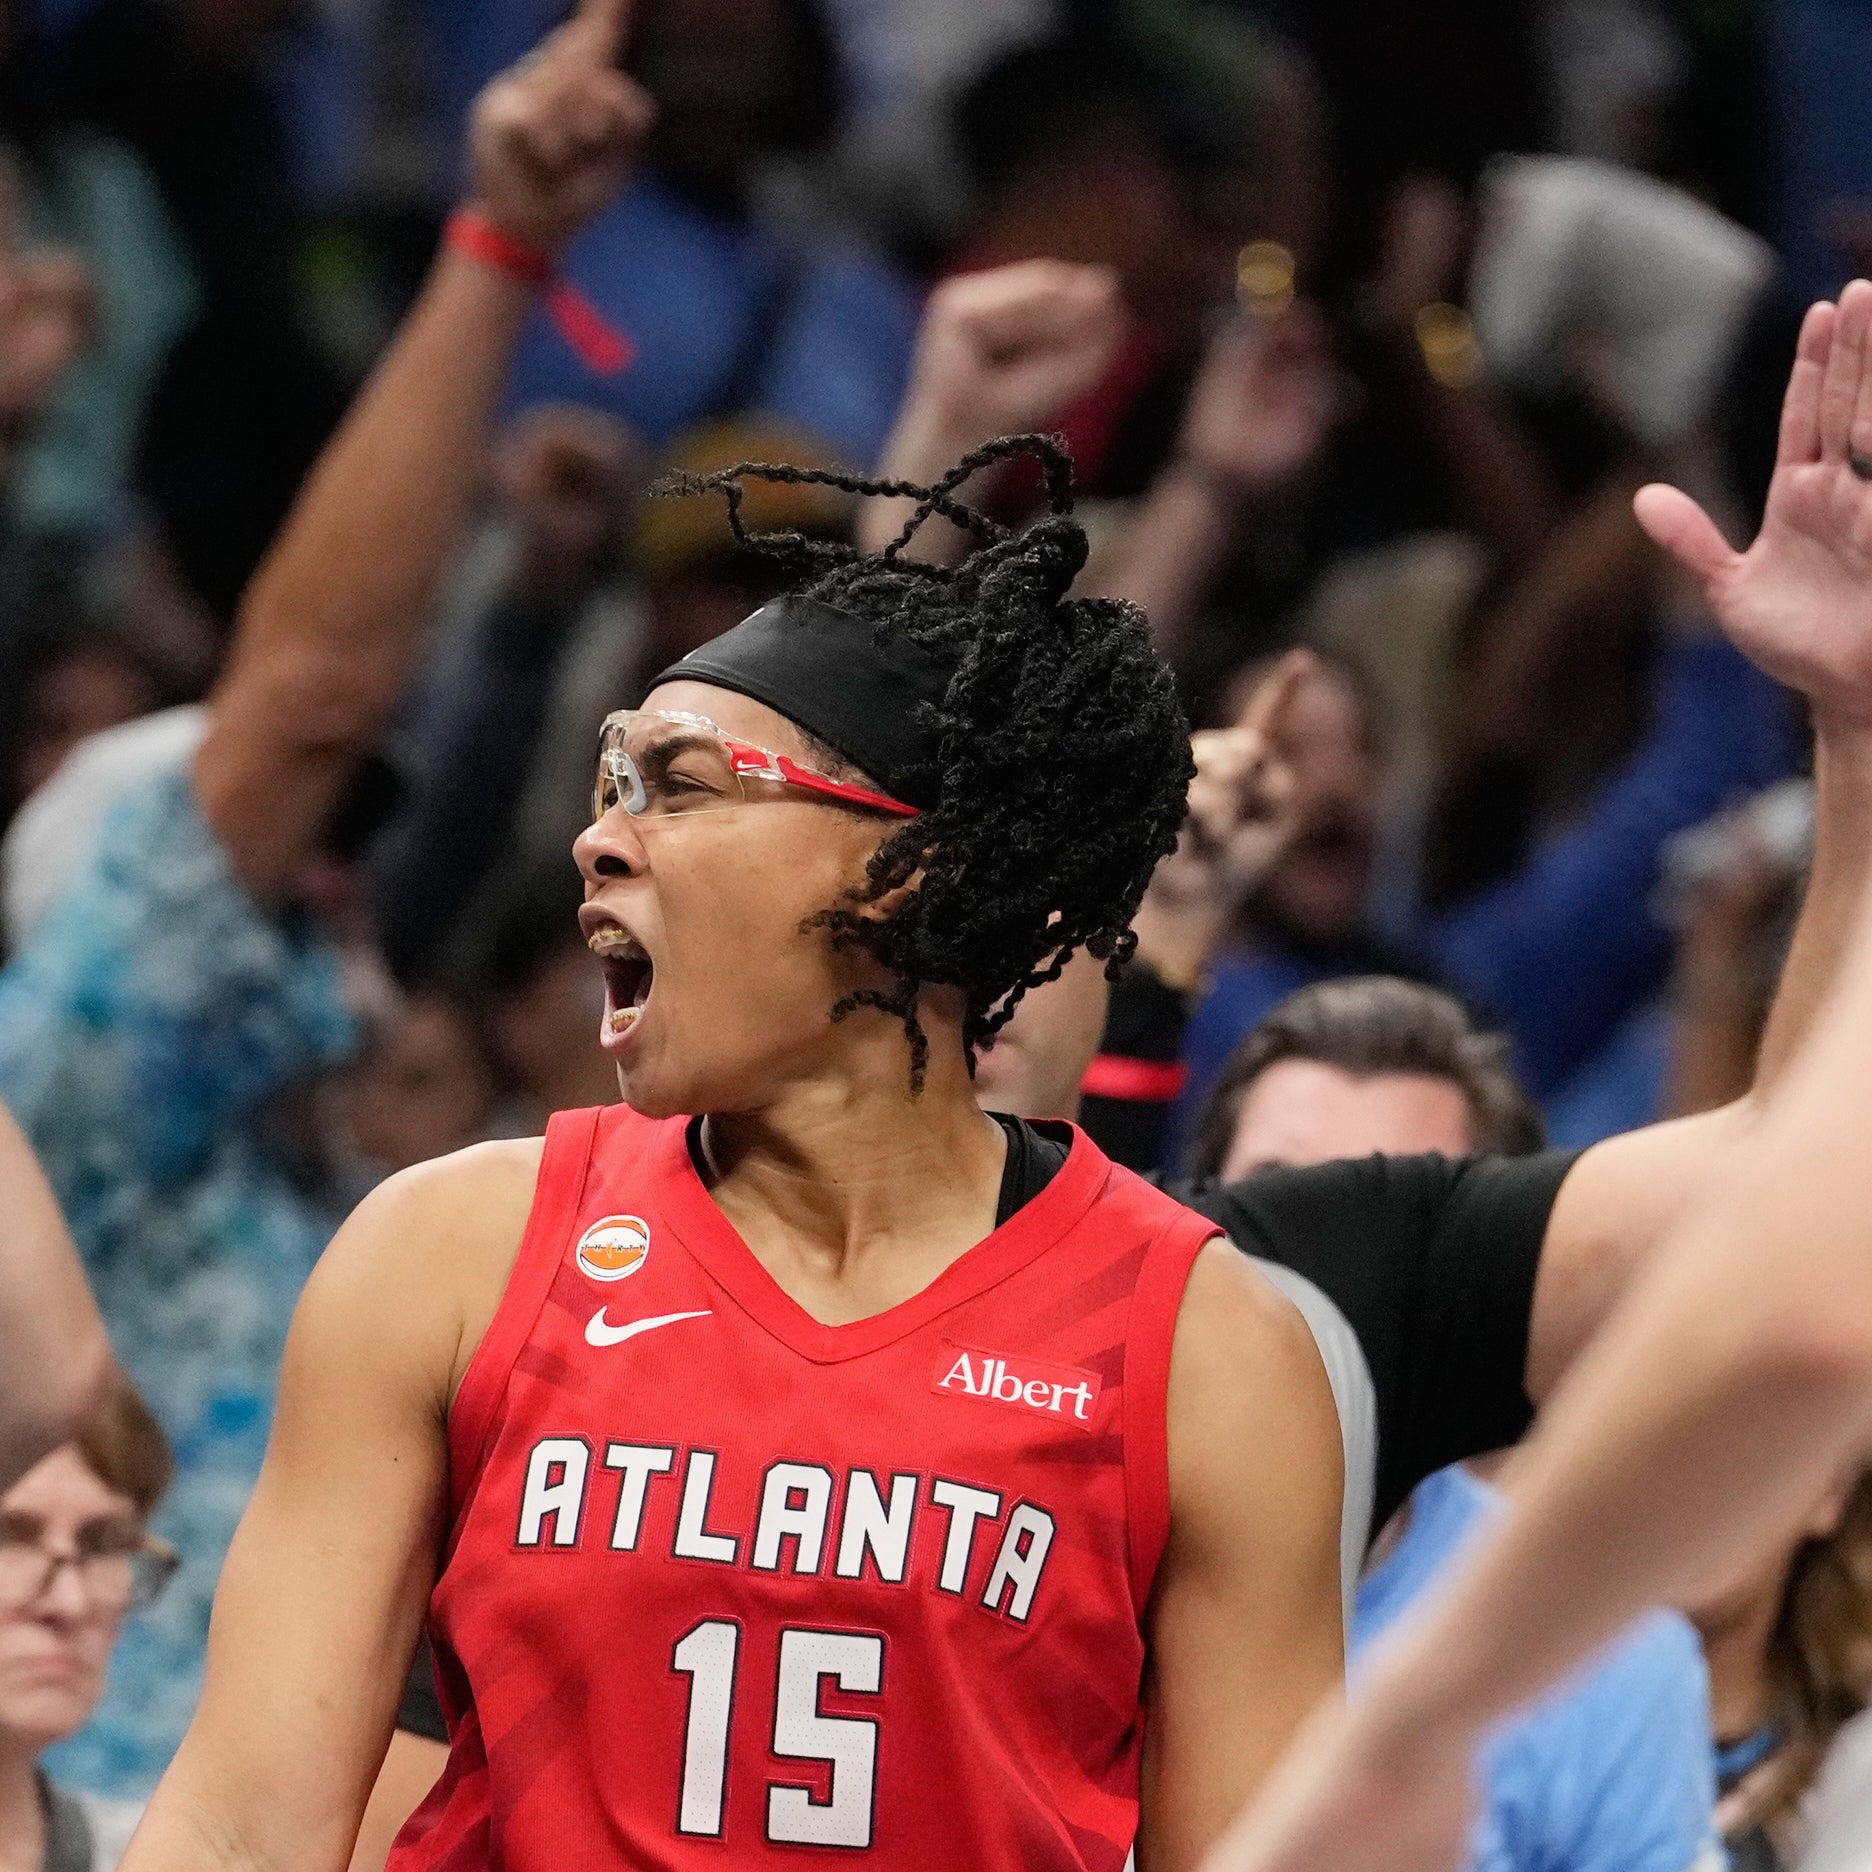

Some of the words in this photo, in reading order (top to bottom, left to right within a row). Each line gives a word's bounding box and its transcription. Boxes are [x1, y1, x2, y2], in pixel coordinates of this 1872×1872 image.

[937, 1352, 1093, 1420] Albert
[512, 1434, 1057, 1622] ATLANTA
[668, 1618, 886, 1850] 15
